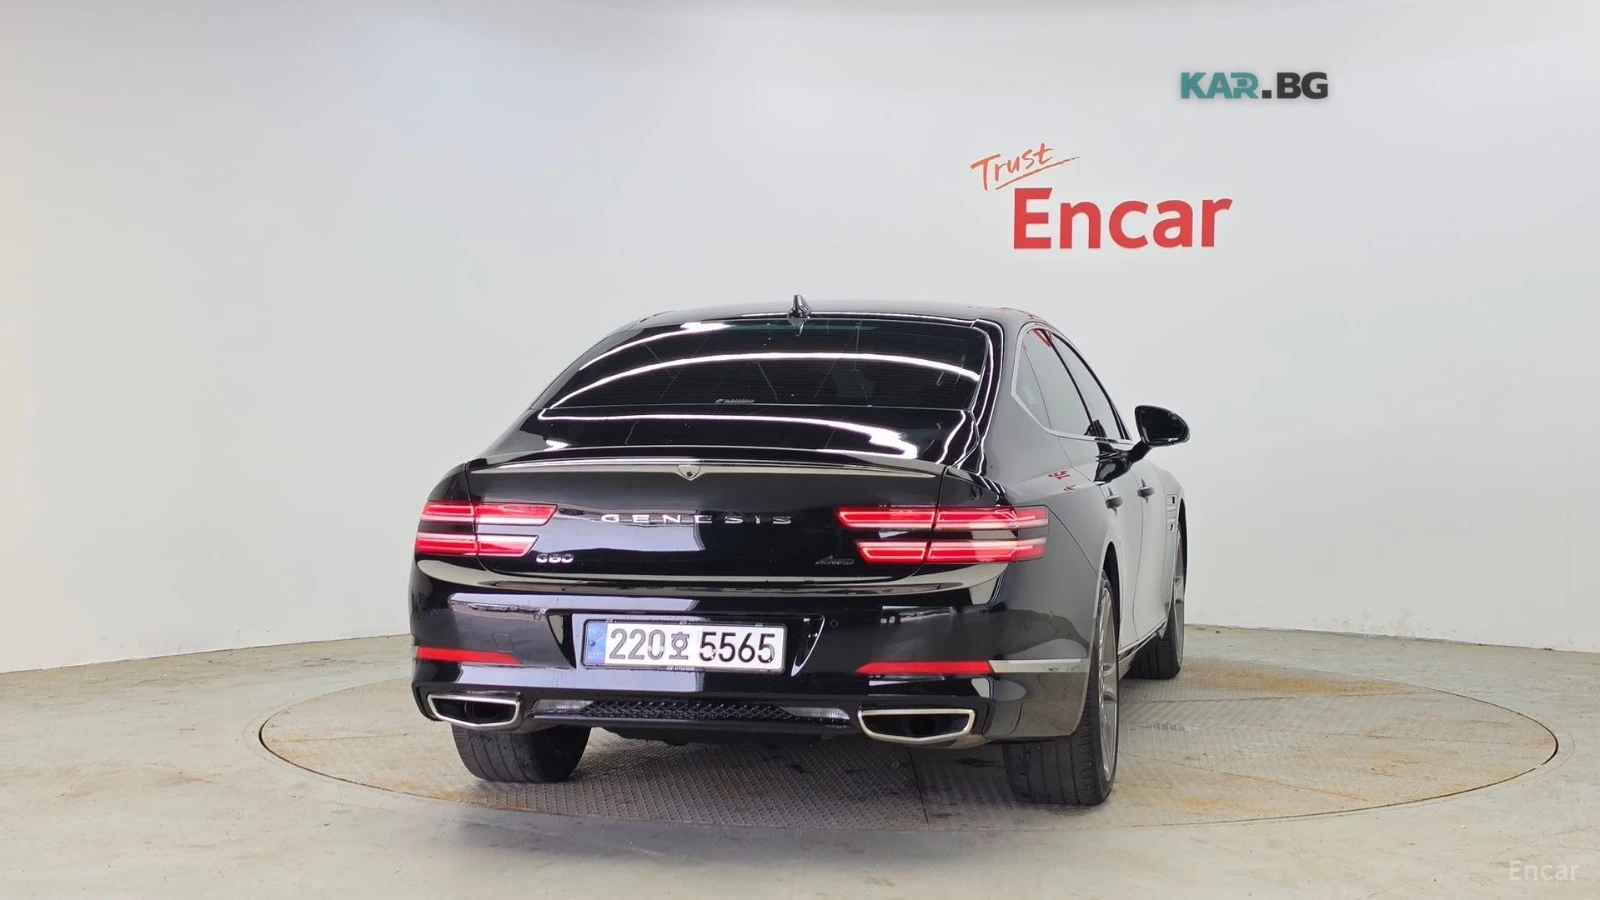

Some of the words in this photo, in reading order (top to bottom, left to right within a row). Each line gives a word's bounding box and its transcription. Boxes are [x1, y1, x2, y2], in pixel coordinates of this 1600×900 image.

[970, 142, 1054, 191] Trust
[1013, 187, 1233, 250] Encar
[600, 513, 793, 526] GENESIS
[608, 627, 690, 661] 220호
[698, 631, 776, 664] 5565
